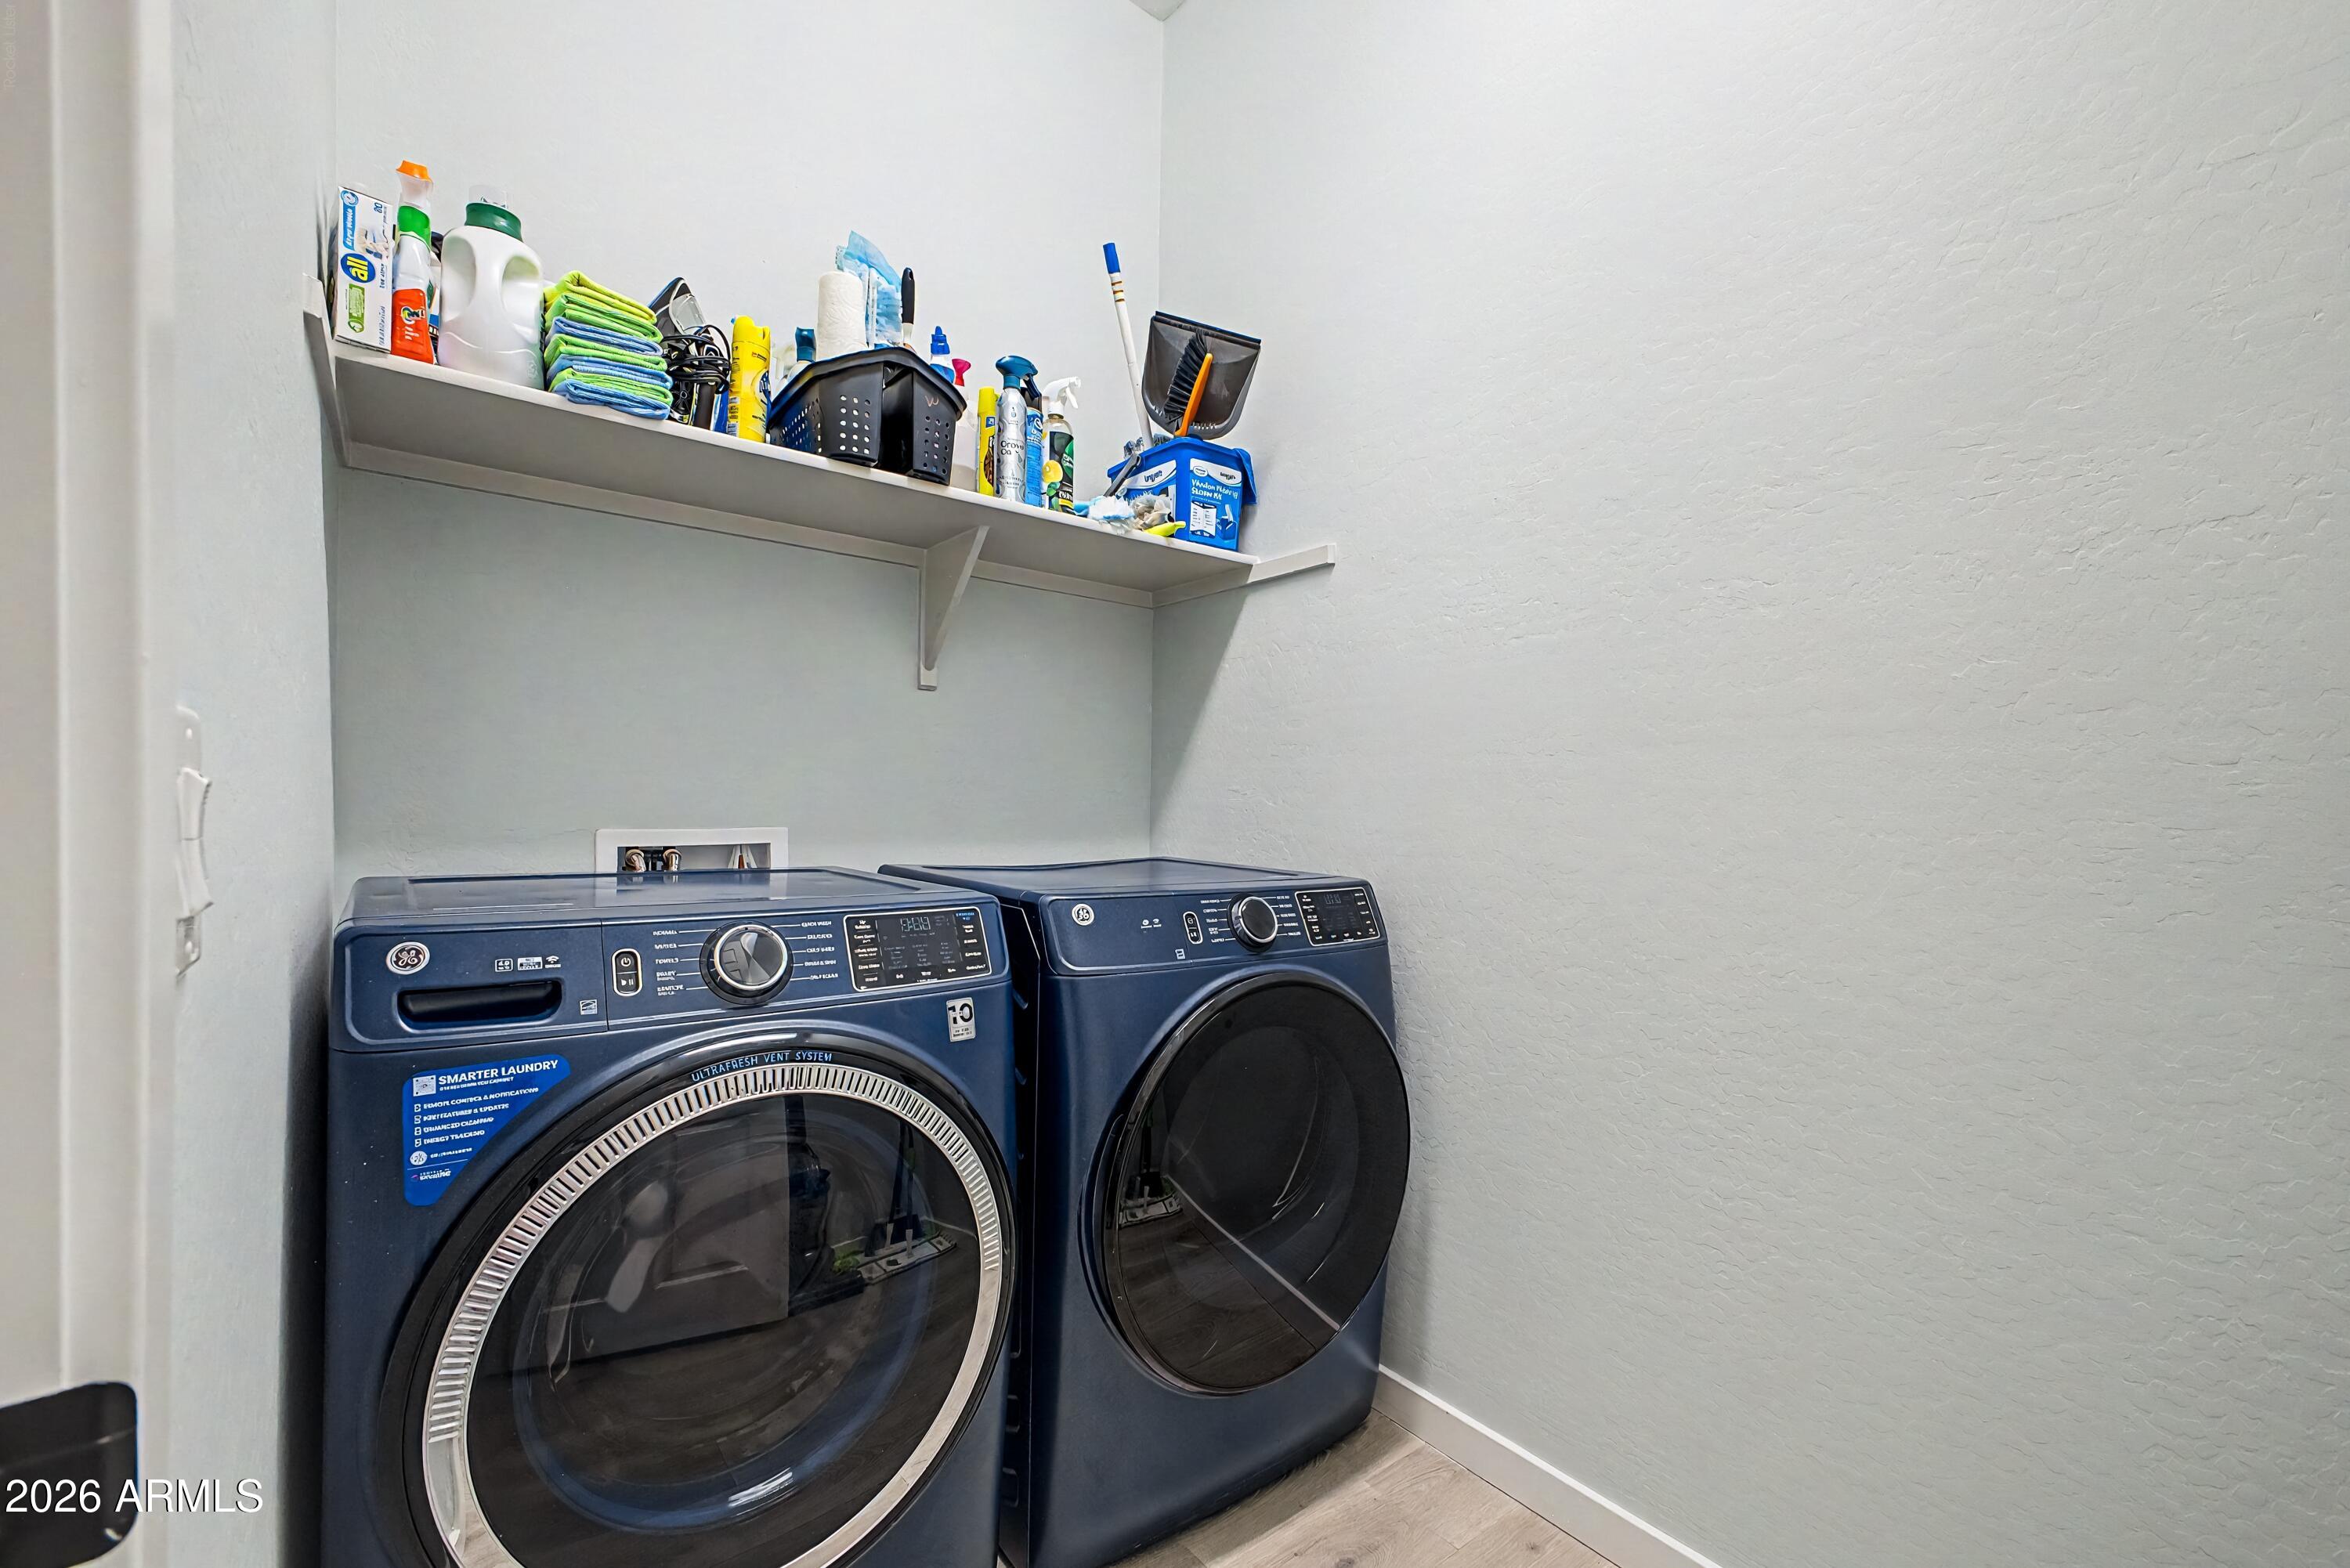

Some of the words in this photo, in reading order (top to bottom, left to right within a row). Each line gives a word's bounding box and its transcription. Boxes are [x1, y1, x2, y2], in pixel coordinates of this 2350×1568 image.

[346, 256, 368, 282] all
[948, 1003, 973, 1024] 10
[438, 1068, 499, 1086] SMARTER
[501, 1060, 559, 1075] LAUNDRY
[691, 1056, 758, 1082] ULTRAFRESH
[764, 1052, 790, 1063] VENT
[795, 1051, 833, 1062] SYSTEM
